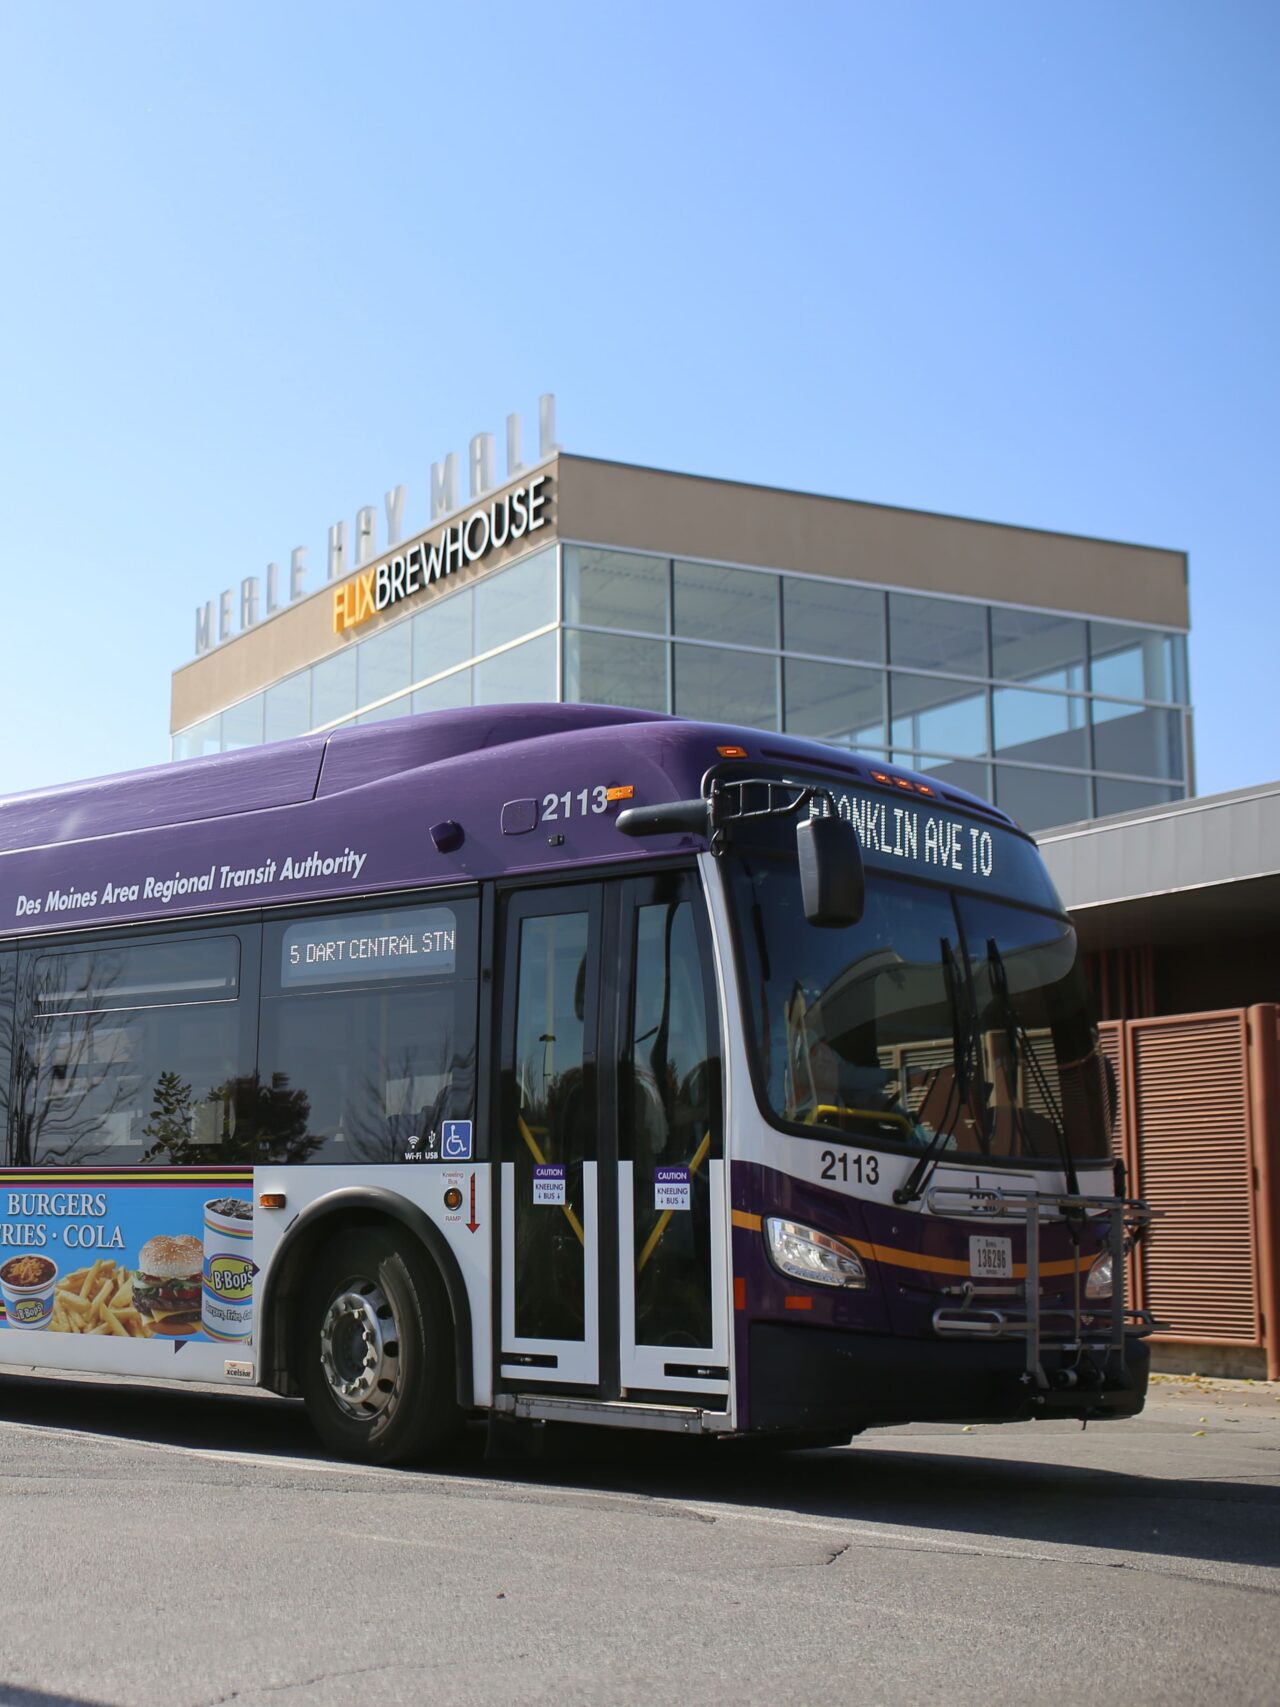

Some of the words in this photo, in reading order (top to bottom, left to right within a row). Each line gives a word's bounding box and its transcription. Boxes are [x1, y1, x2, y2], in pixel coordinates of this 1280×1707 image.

[327, 485, 407, 580] HAY
[431, 392, 562, 522] MALL
[542, 785, 608, 822] 2113
[925, 817, 963, 870] AVE
[970, 828, 993, 877] TO
[15, 895, 42, 917] Des
[45, 886, 98, 913] Moines
[101, 882, 140, 905] Area
[143, 865, 216, 903] Regional
[220, 858, 277, 889] Transit
[279, 847, 368, 879] Authority
[290, 945, 300, 964] 5
[306, 941, 346, 963] DART
[349, 935, 418, 959] CENTRAL
[422, 930, 455, 953] STN
[404, 1152, 422, 1160] Wi-Fi
[425, 1151, 439, 1160] USB
[536, 1168, 563, 1177] CAUTION
[657, 1172, 687, 1180] CAUTION
[820, 1150, 880, 1186] 2113
[535, 1183, 564, 1191] KNEELING
[657, 1187, 689, 1195] KNEELING
[7, 1193, 108, 1216] BURGERS
[666, 1197, 679, 1205] BUS
[63, 1224, 126, 1249] COLA
